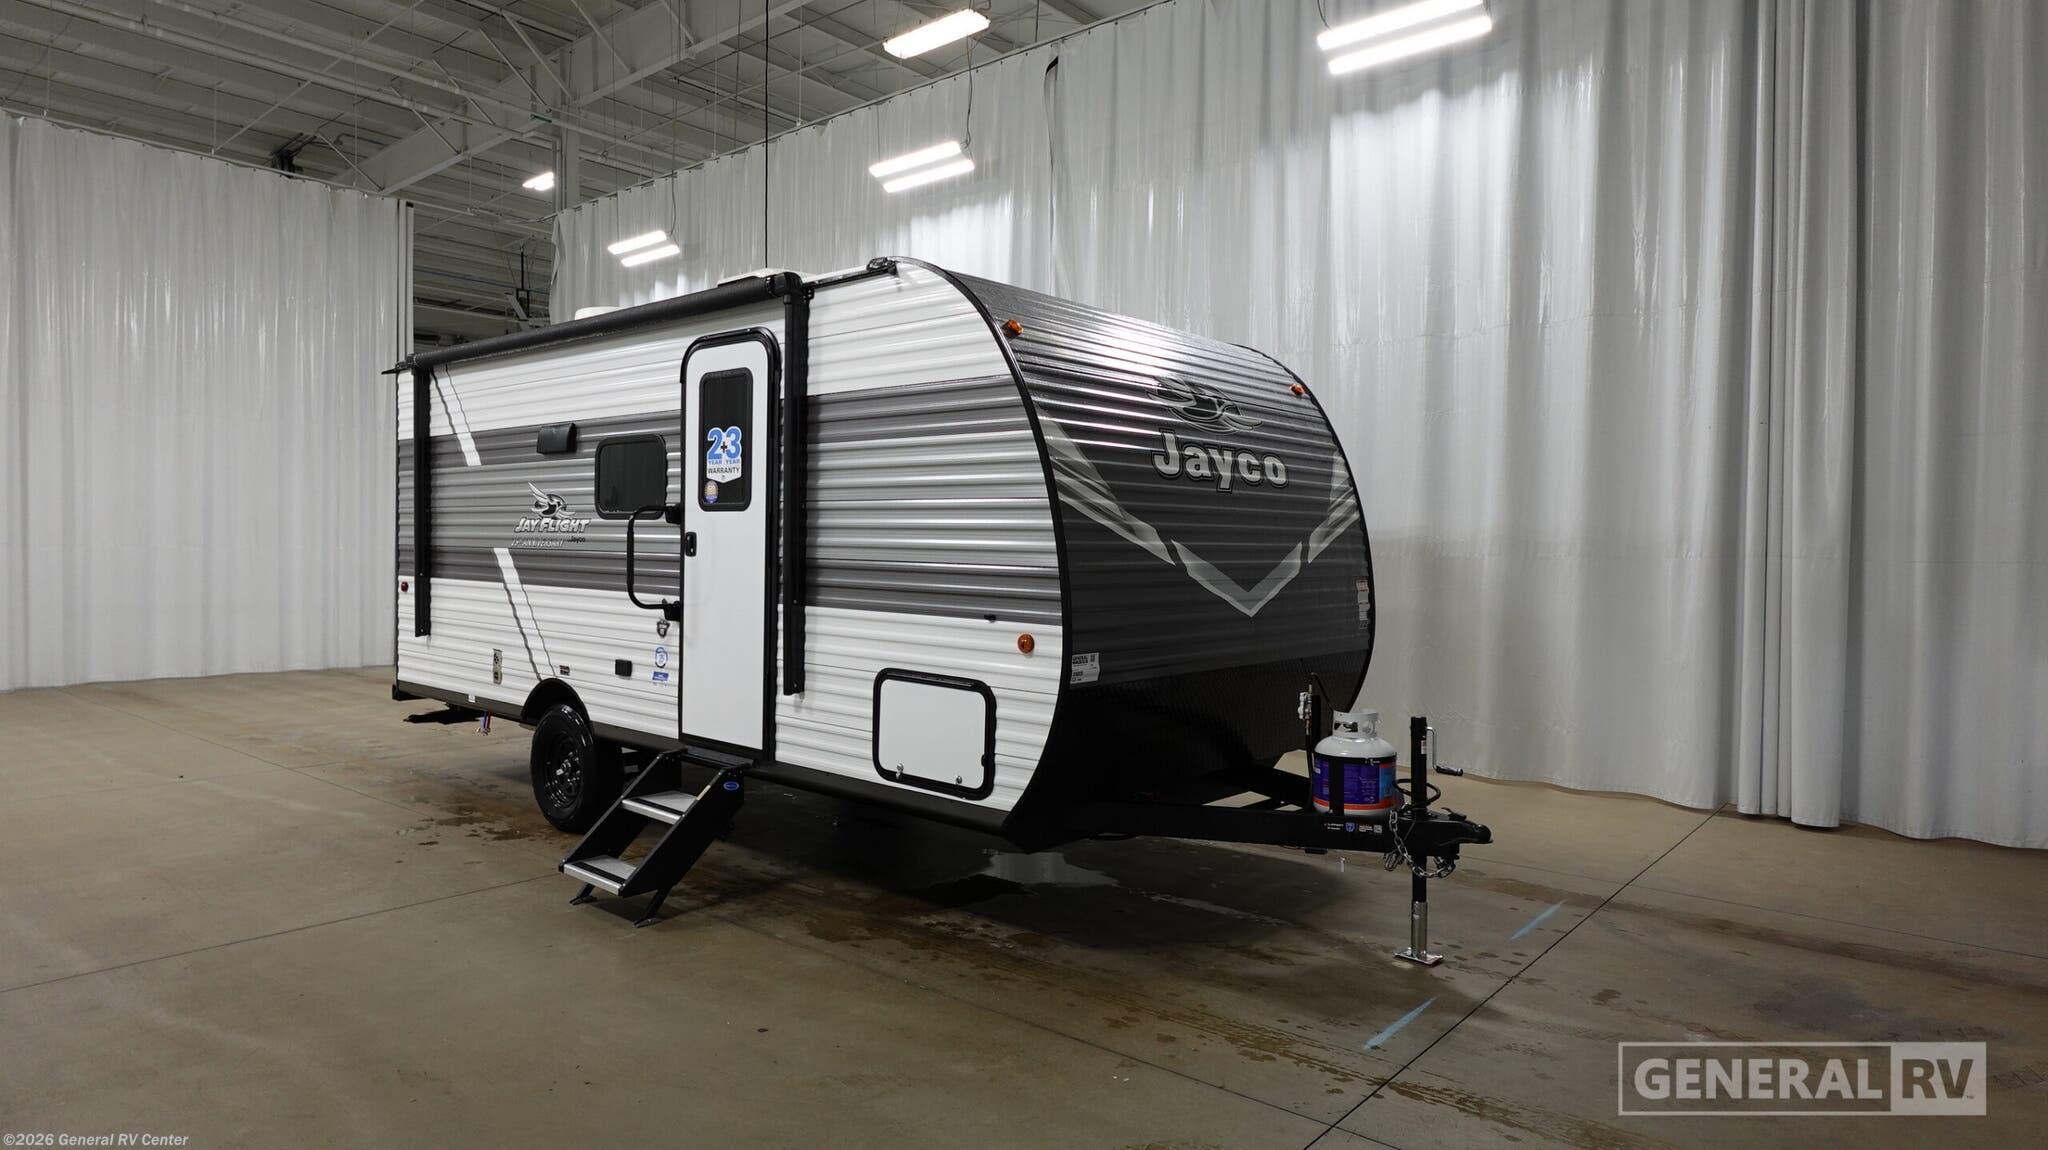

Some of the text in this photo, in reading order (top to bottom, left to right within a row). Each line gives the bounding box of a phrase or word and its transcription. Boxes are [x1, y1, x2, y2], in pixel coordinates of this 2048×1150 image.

[1151, 429, 1289, 493] Jayco
[514, 517, 590, 533] JAY FLIGHT
